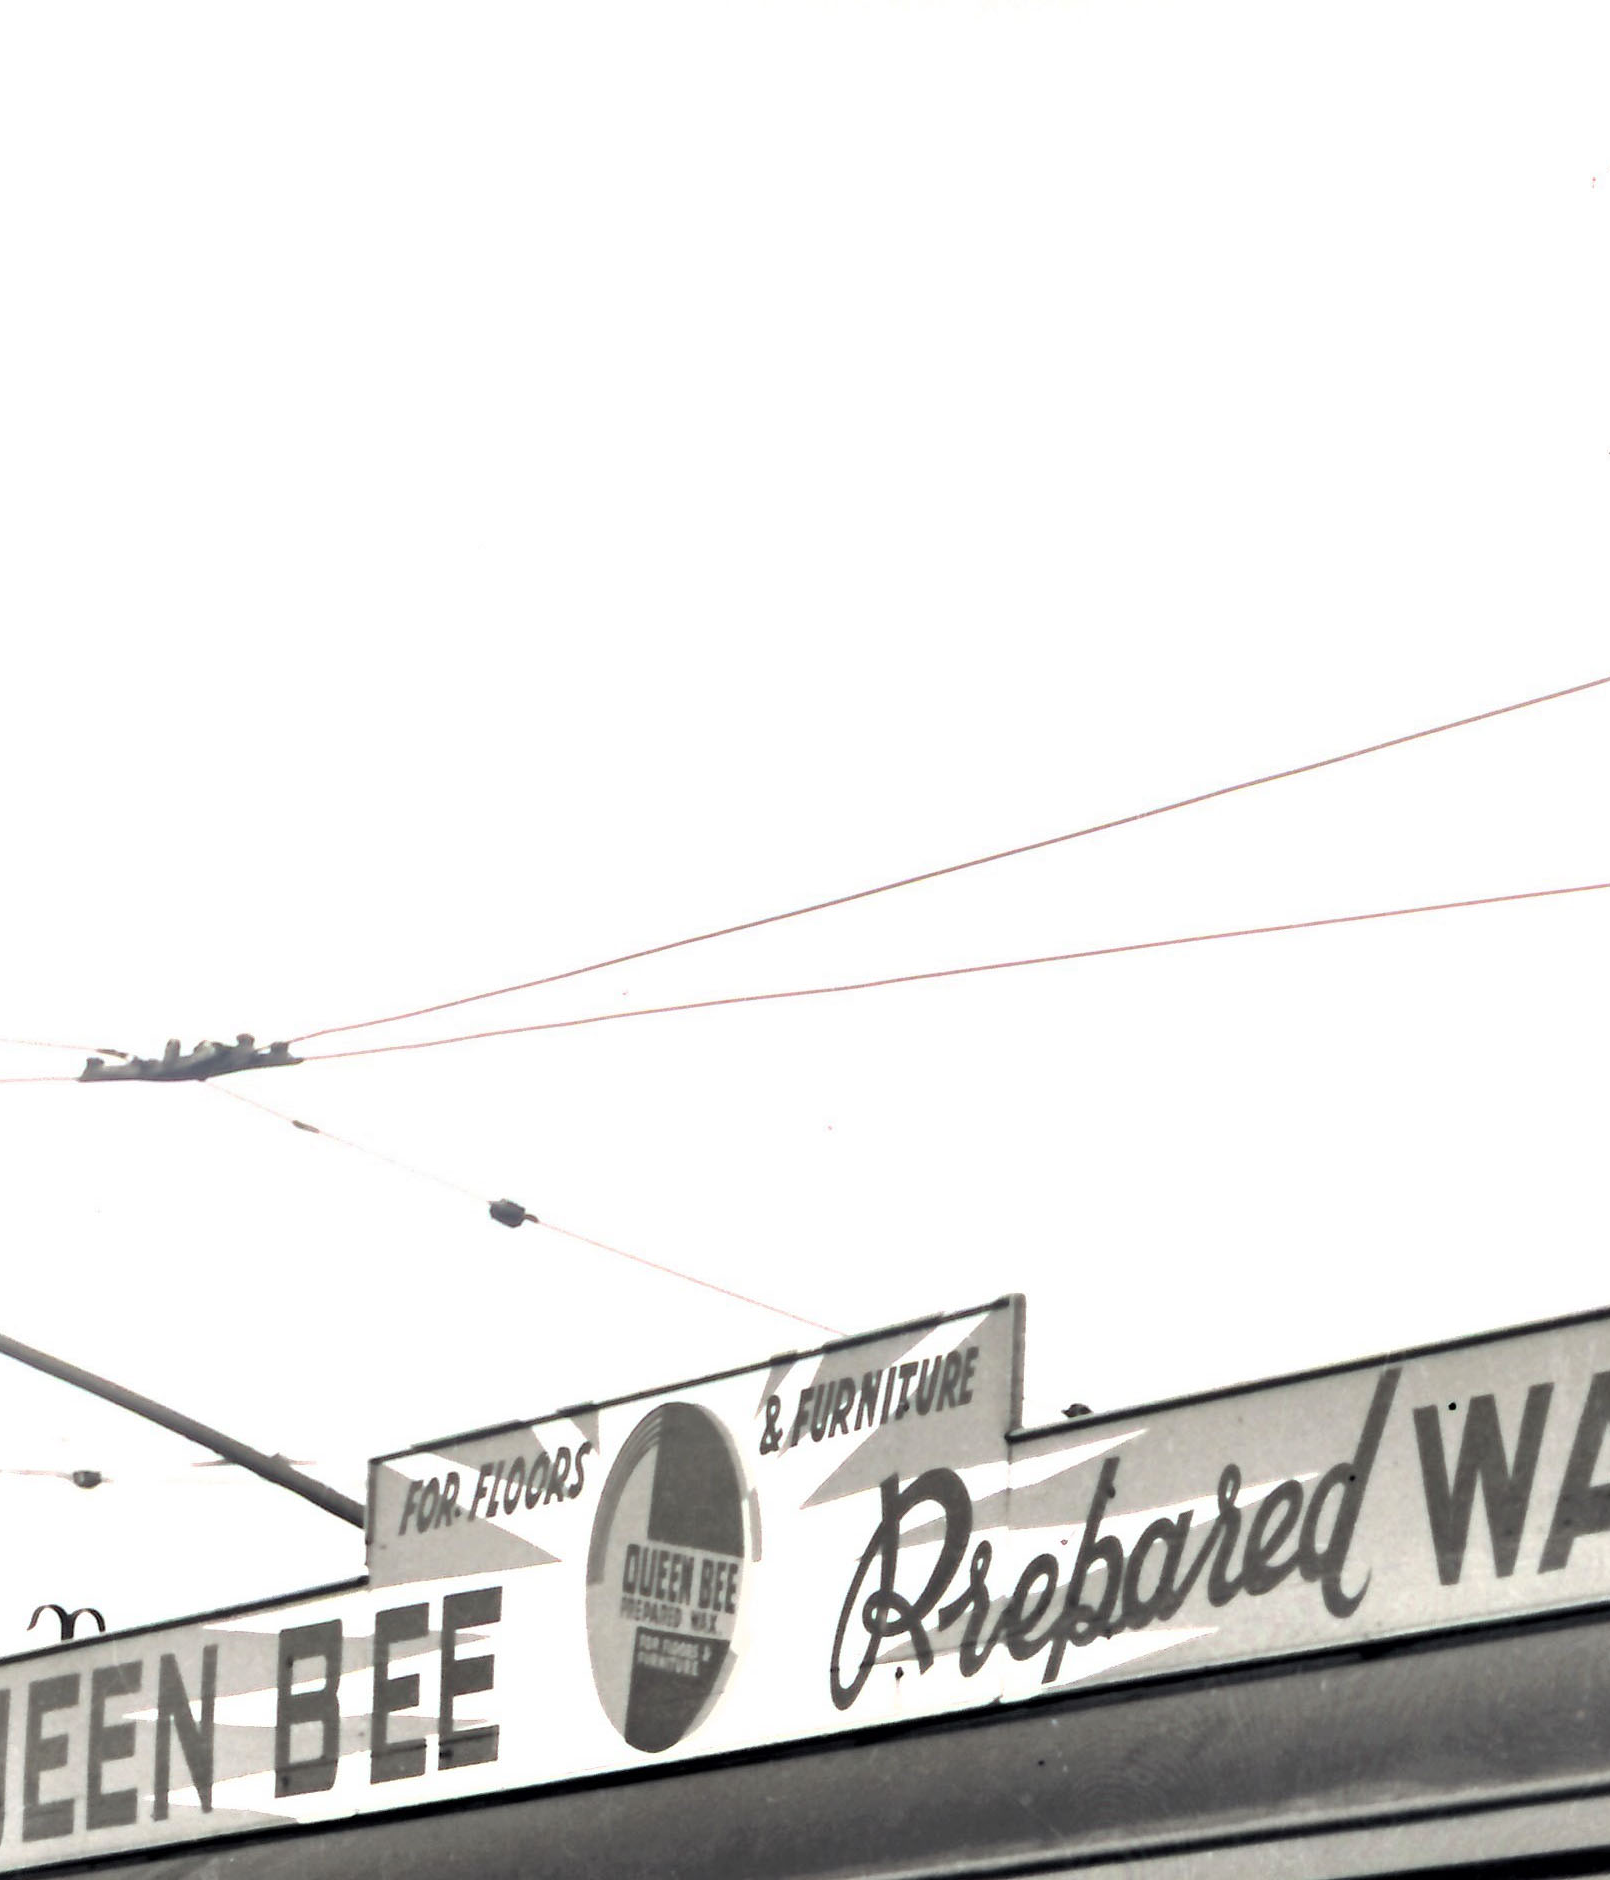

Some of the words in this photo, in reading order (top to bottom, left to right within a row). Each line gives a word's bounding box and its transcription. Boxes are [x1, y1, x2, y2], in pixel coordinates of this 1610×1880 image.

[467, 1441, 593, 1522] FLOORS
[758, 1394, 783, 1456] &
[790, 1346, 980, 1449] FURNITURE
[275, 1586, 503, 1799] BEE
[828, 1364, 1399, 1711] Prepared
[623, 1544, 694, 1606] QUEEN
[699, 1559, 738, 1614] BEE
